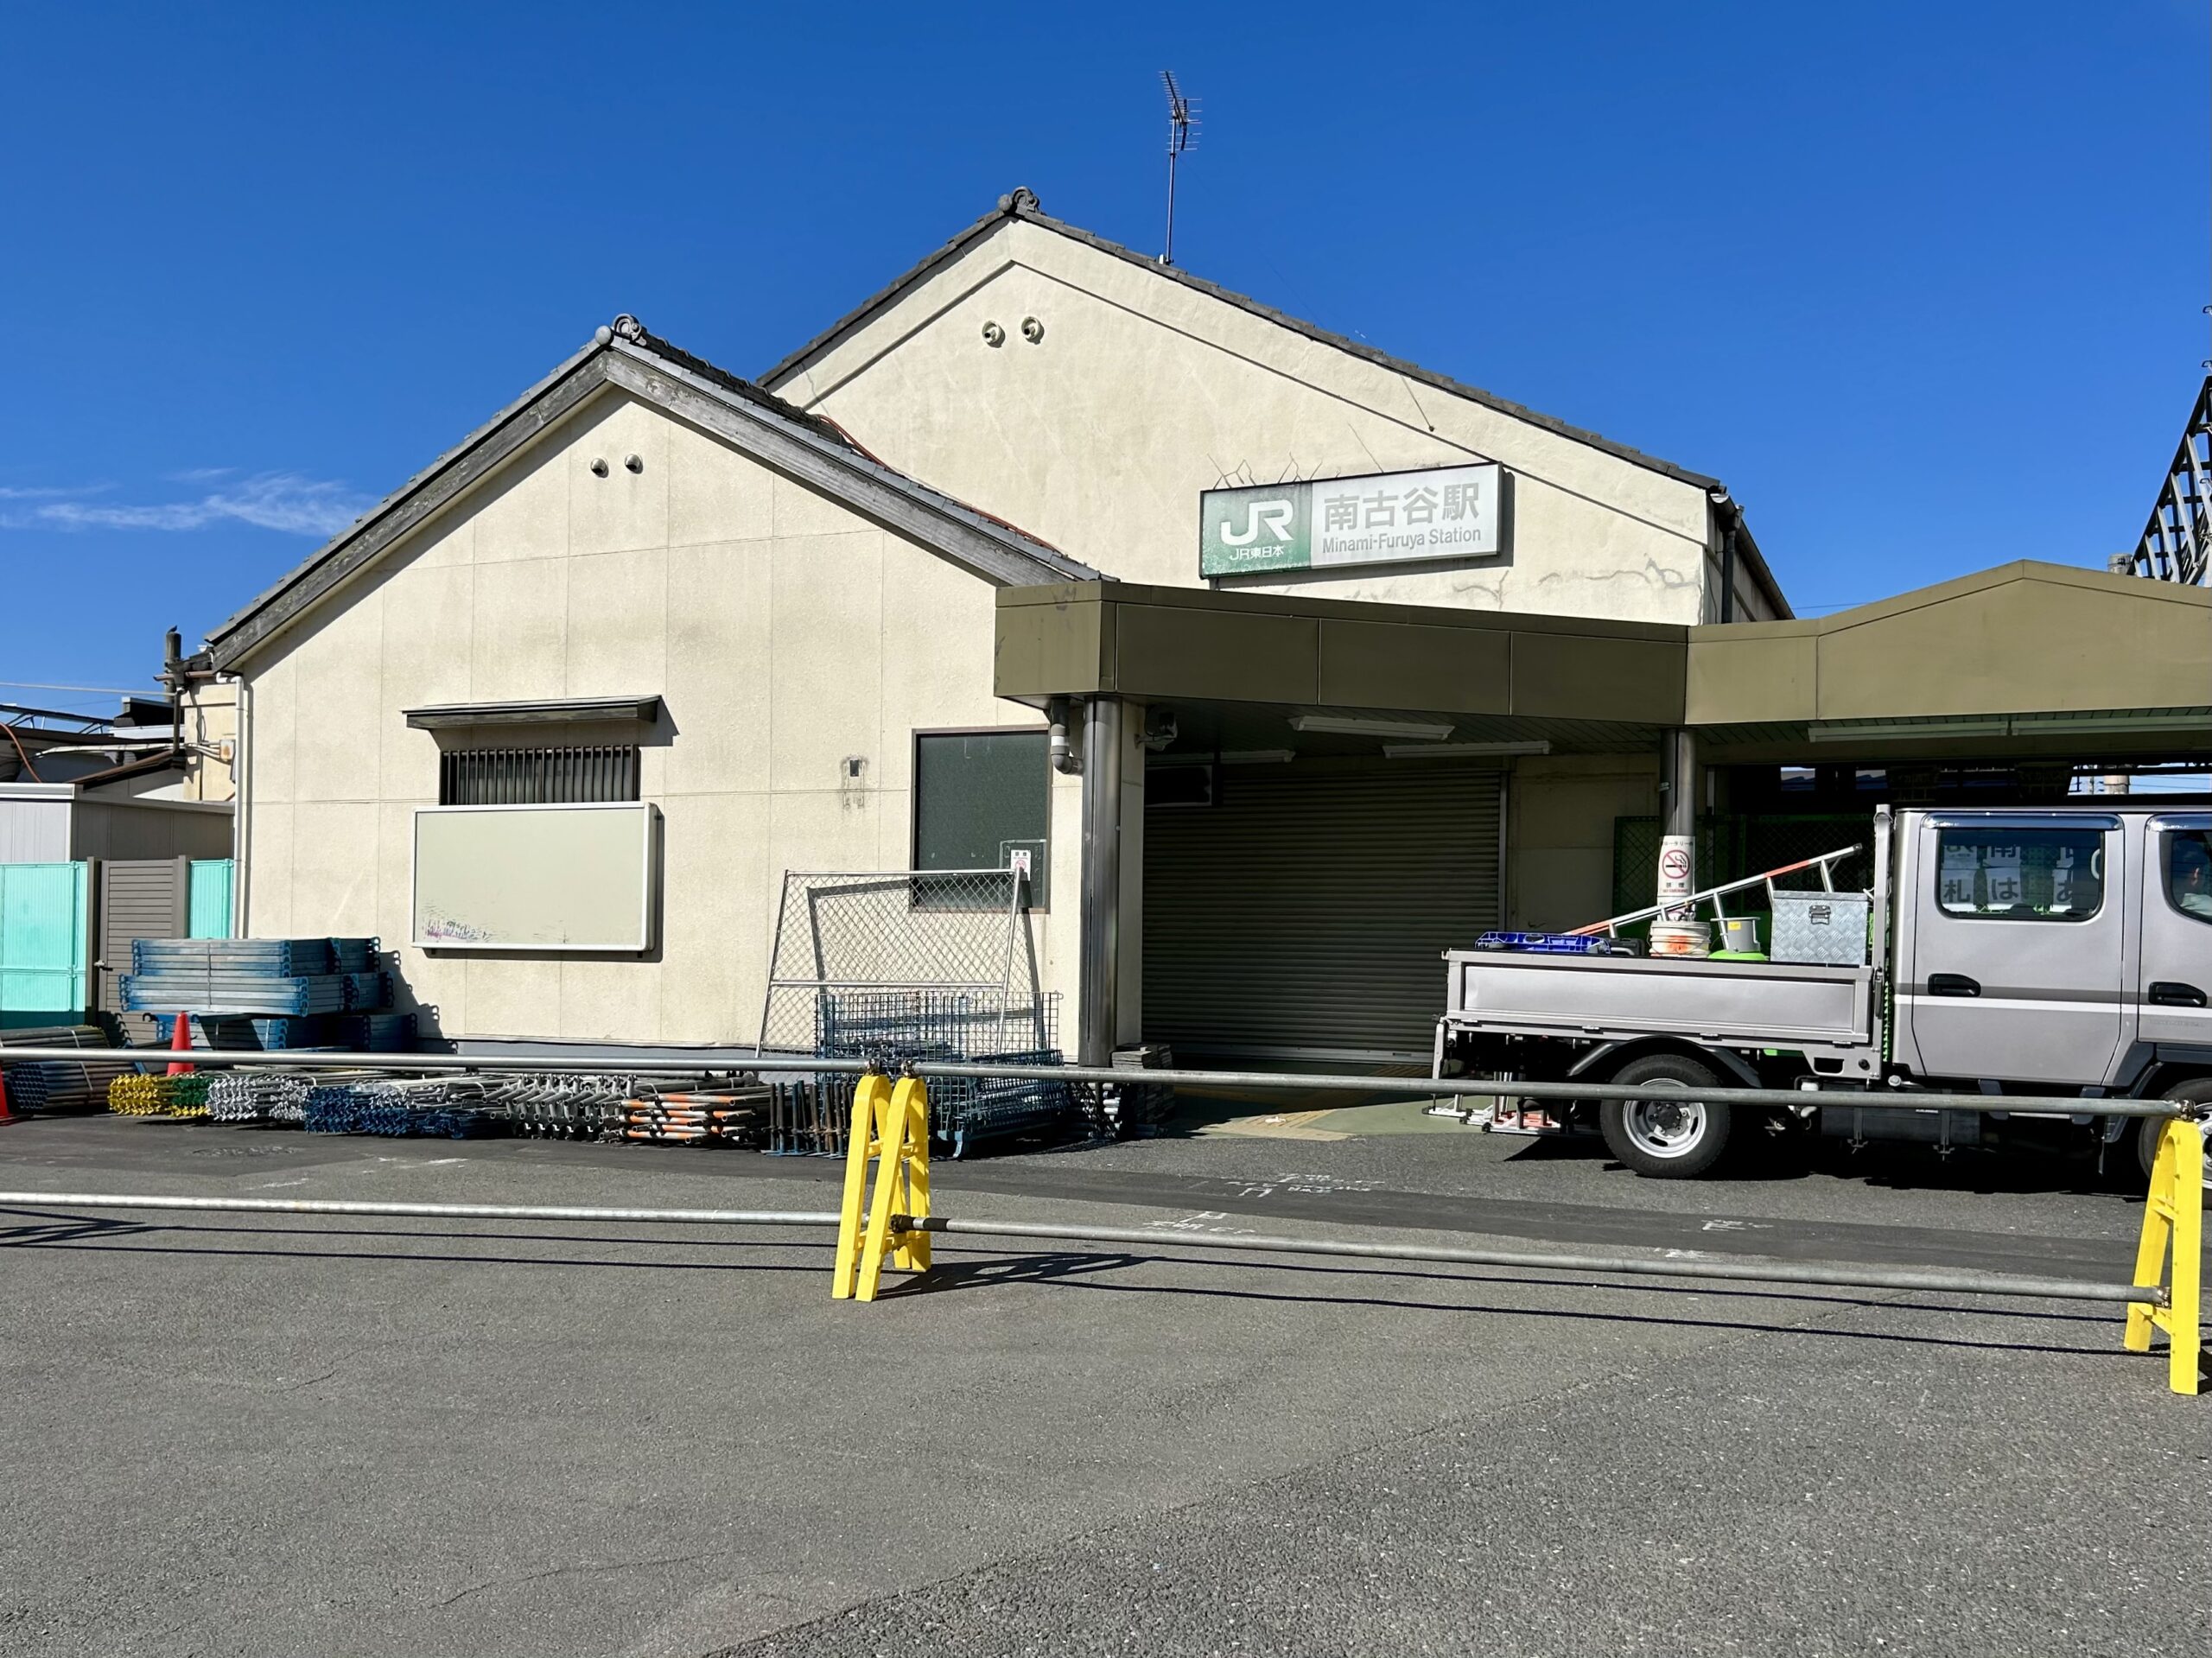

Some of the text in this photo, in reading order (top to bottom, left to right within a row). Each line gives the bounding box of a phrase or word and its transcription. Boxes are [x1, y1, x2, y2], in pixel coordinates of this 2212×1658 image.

[1220, 500, 1294, 546] JR
[1324, 481, 1480, 533] 南古谷駅
[1229, 544, 1285, 562] JR東日本
[1322, 527, 1482, 554] Minami-Furuya Station
